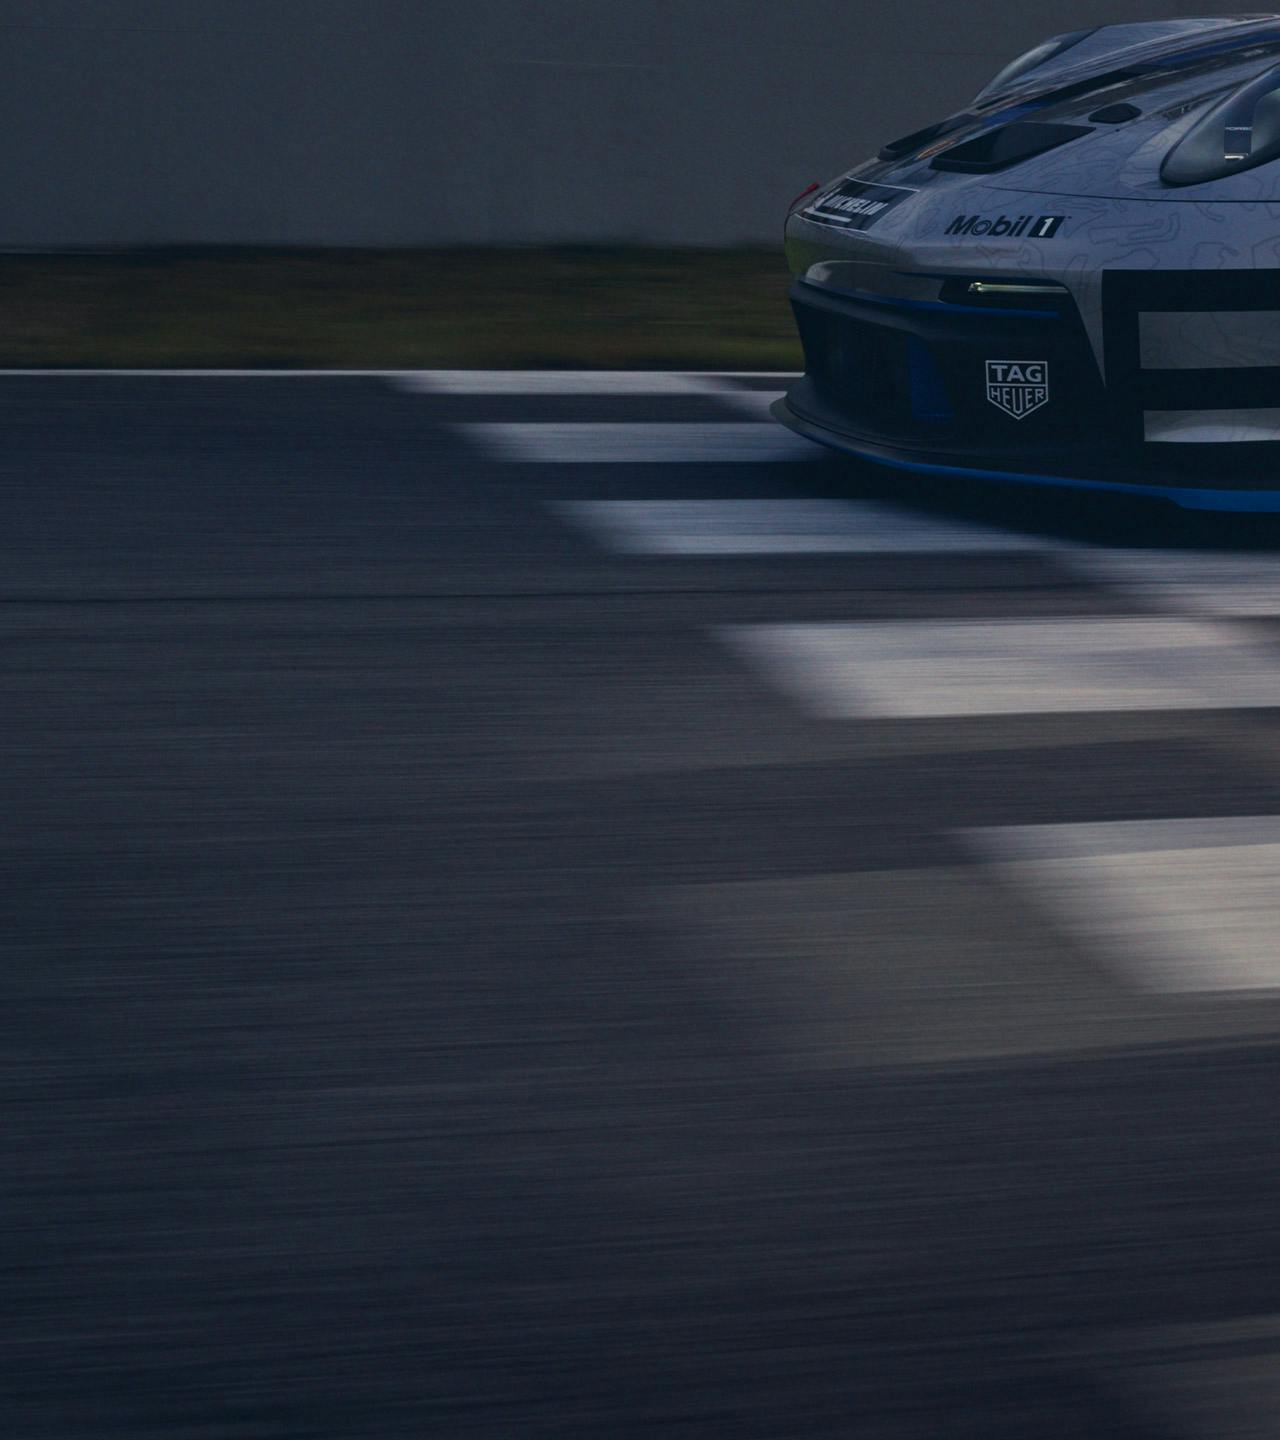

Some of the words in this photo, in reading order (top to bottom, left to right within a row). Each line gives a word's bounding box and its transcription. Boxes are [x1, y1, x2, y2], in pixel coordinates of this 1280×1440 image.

[944, 215, 1034, 236] Mobil
[991, 365, 1042, 382] TAG
[991, 388, 1045, 414] HEUER
